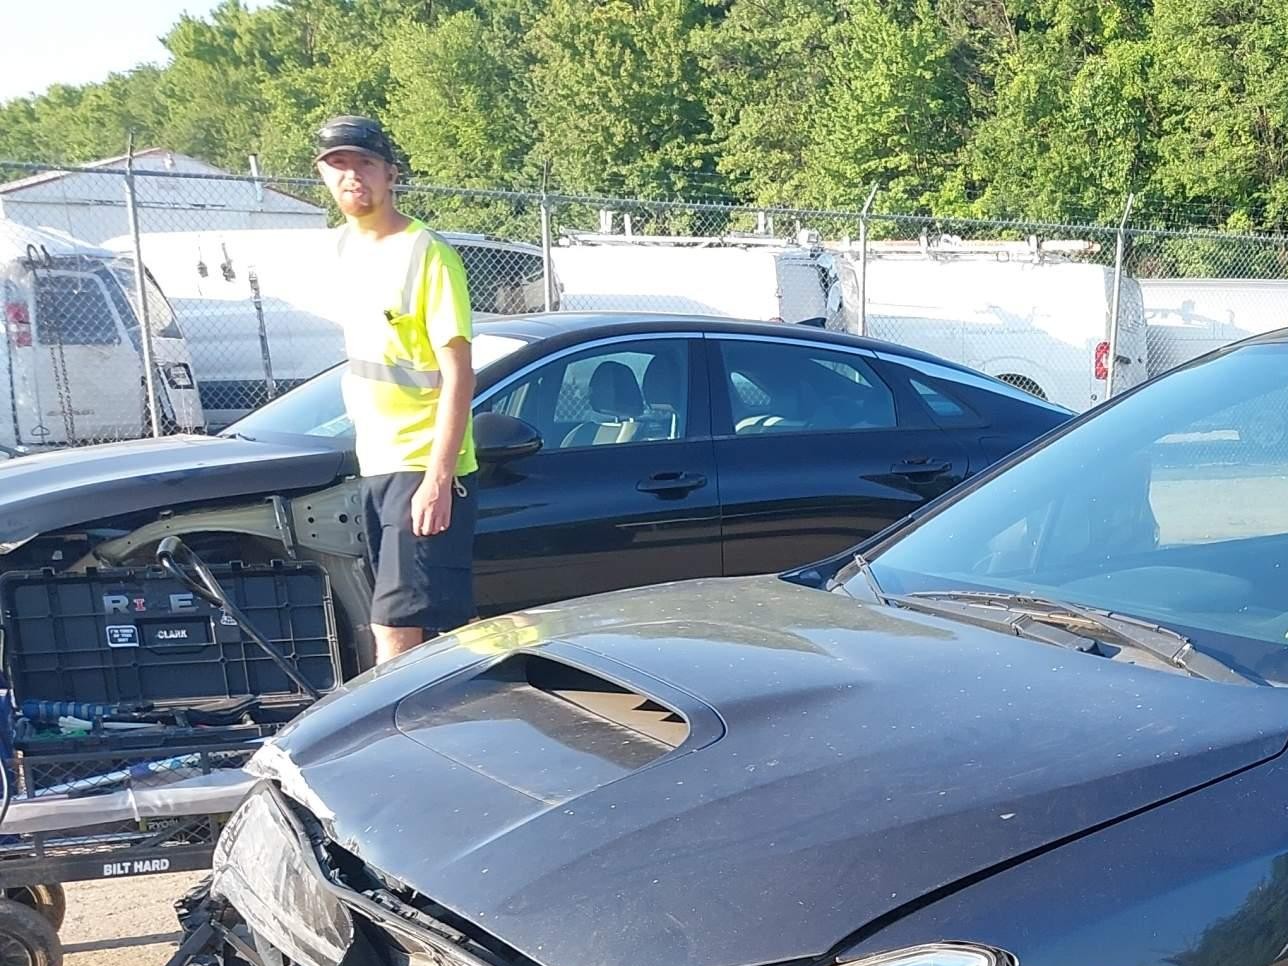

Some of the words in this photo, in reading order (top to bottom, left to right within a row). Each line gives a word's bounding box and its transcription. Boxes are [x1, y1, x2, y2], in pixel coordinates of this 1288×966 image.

[157, 629, 188, 639] CLARK
[103, 862, 131, 876] BILT
[133, 858, 170, 873] HARD
